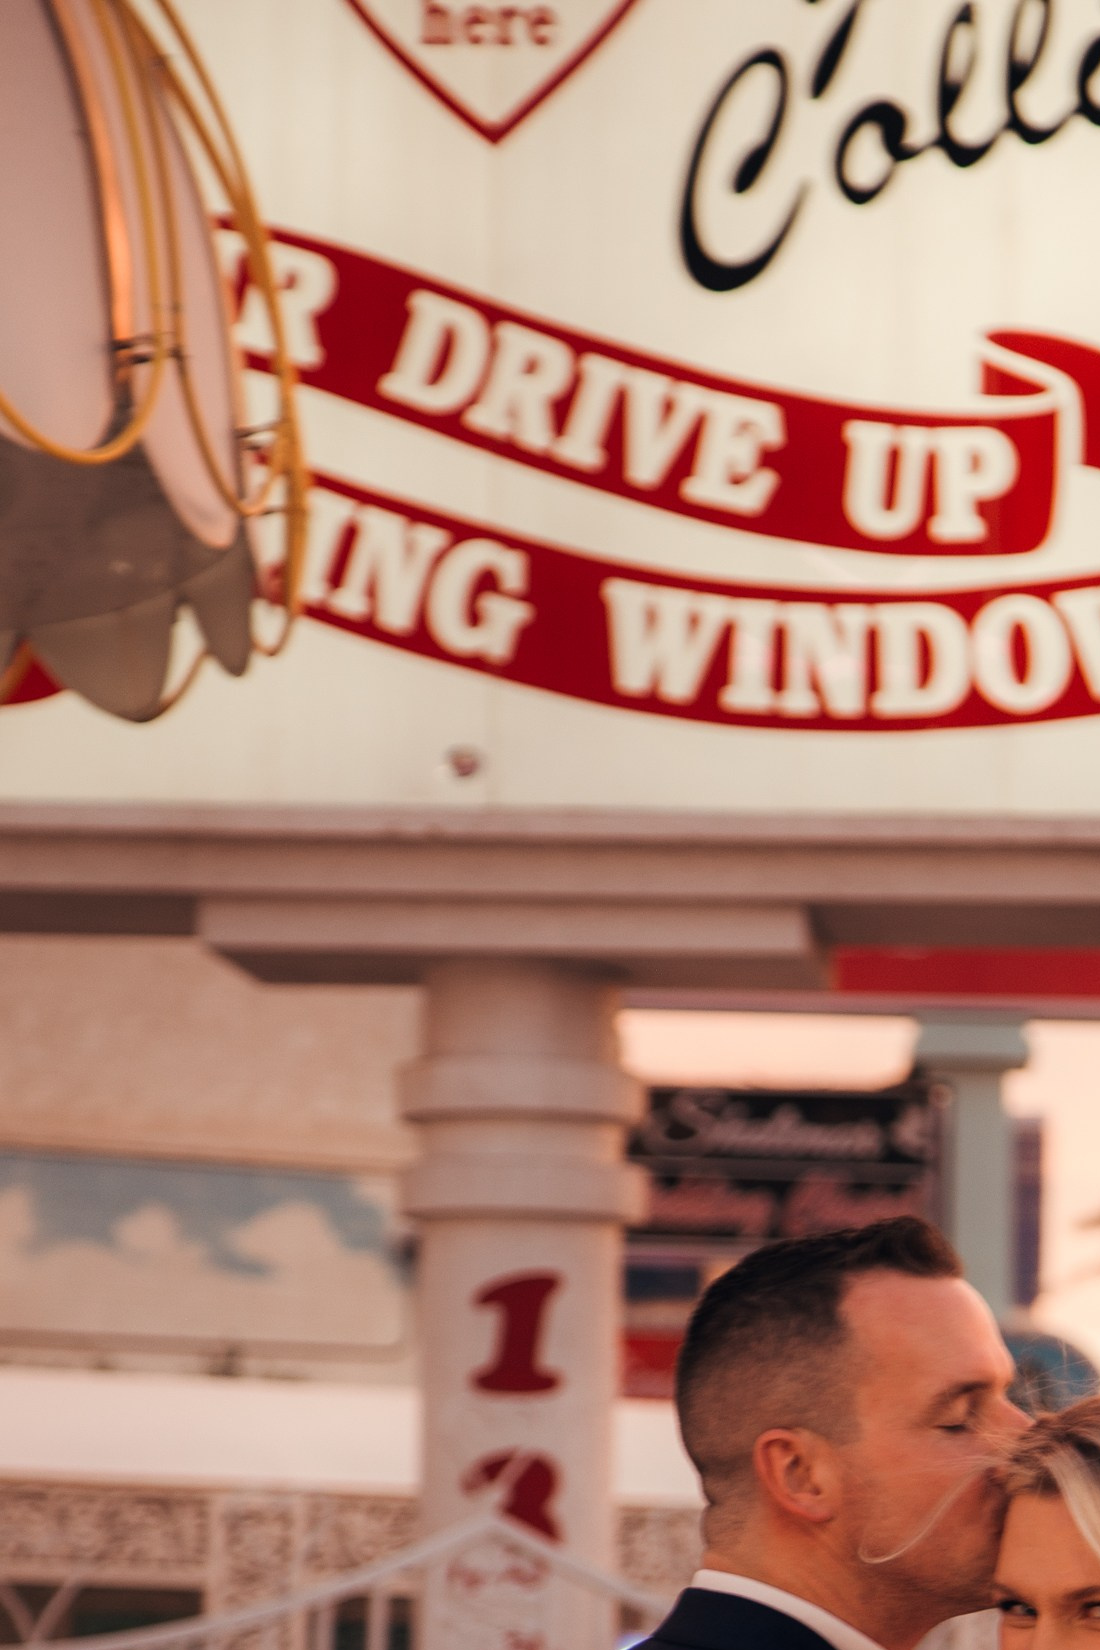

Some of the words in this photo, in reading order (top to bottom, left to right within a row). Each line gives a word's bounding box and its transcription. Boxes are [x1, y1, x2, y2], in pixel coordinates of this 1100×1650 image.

[420, 0, 556, 46] here
[212, 230, 338, 369] R
[378, 288, 785, 516] DRIVE
[840, 420, 1020, 543] UP
[253, 466, 538, 664] ING
